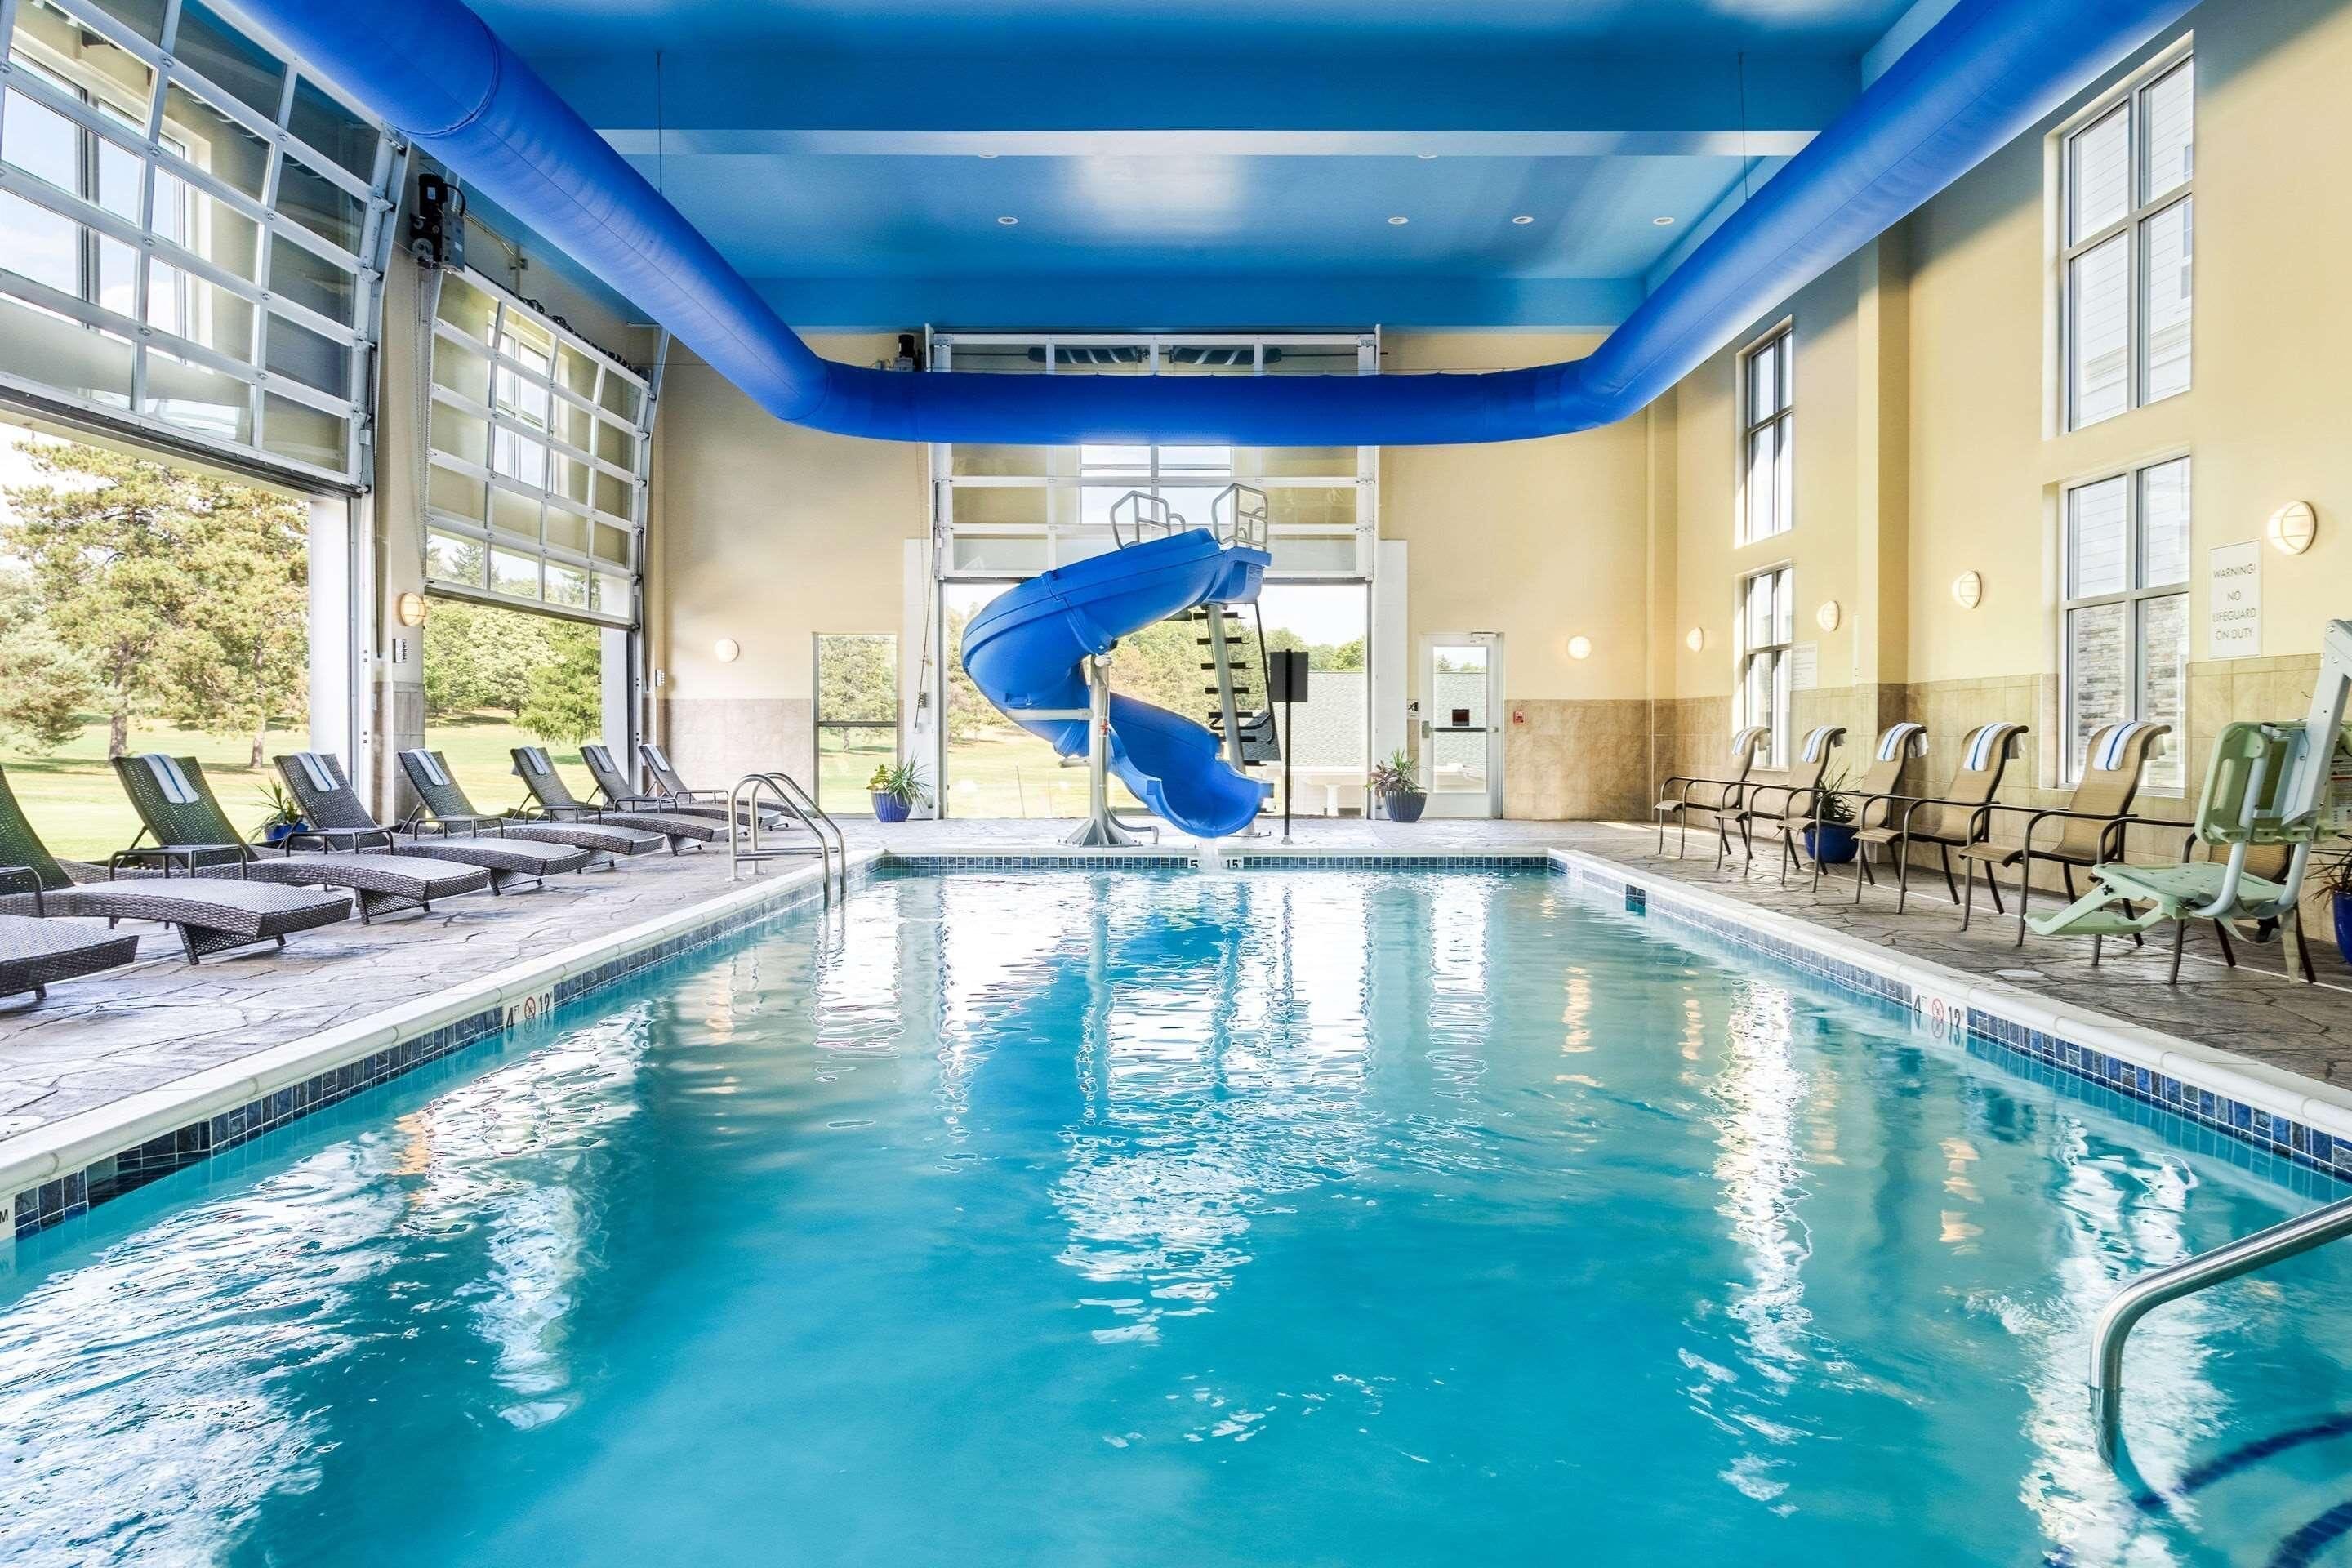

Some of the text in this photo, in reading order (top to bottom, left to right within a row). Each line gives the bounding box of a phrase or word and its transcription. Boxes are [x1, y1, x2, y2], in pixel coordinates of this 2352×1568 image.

[2213, 564, 2256, 579] WARNING!
[2227, 590, 2241, 601] NO
[2212, 608, 2256, 622] LIFEGUARD
[2215, 627, 2253, 640] ON DUTY
